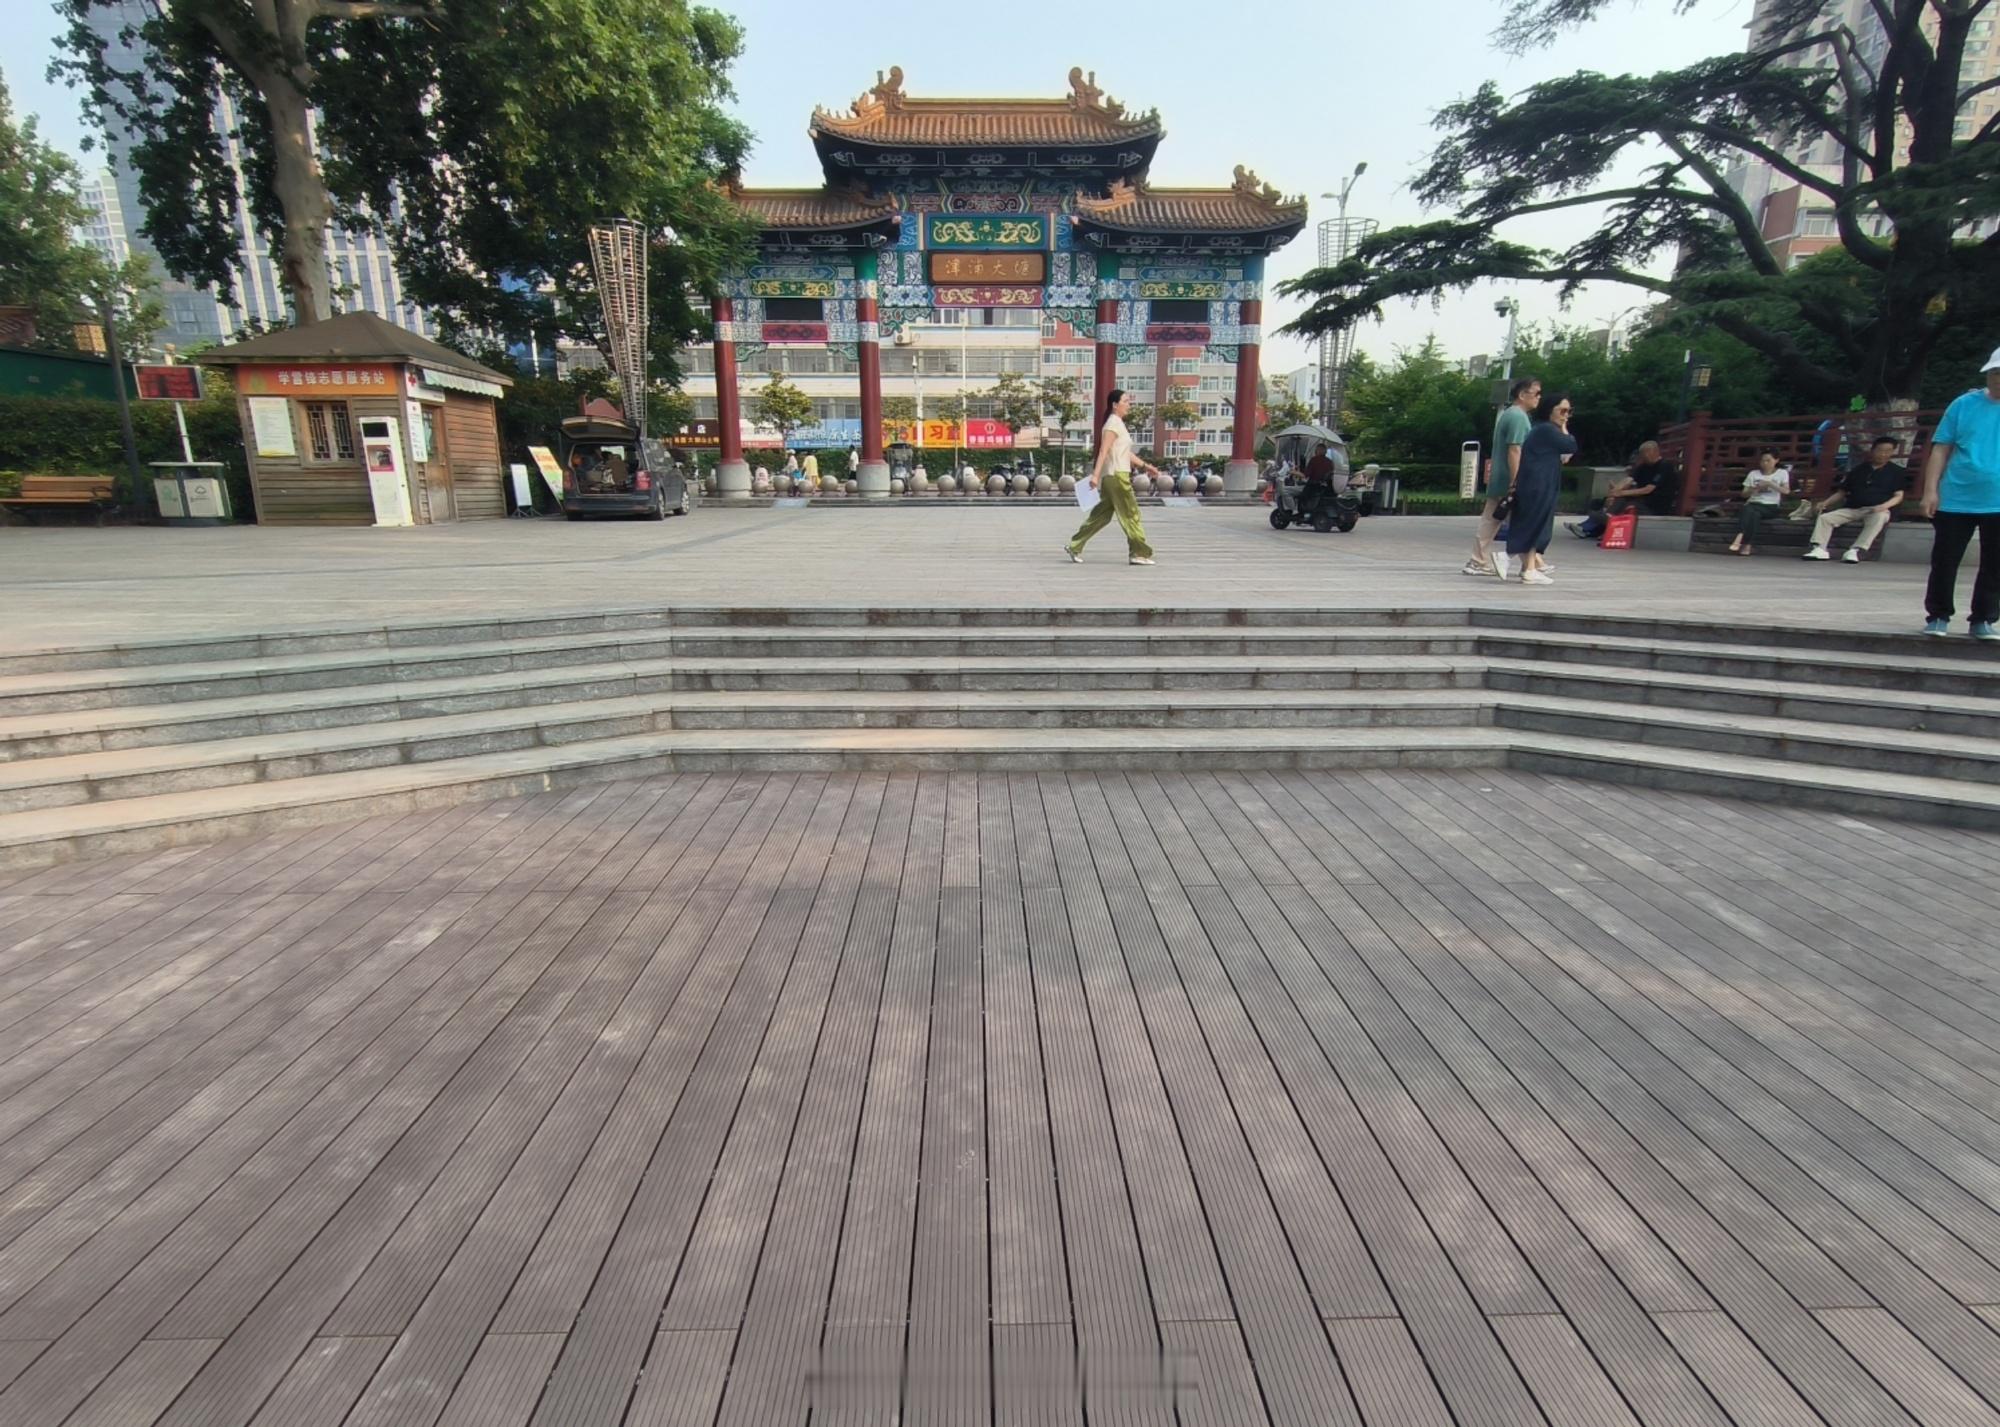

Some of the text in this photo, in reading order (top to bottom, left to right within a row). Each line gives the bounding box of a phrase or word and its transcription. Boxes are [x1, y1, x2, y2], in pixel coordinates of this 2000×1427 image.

[278, 370, 385, 385] 学雷锋志愿服务站
